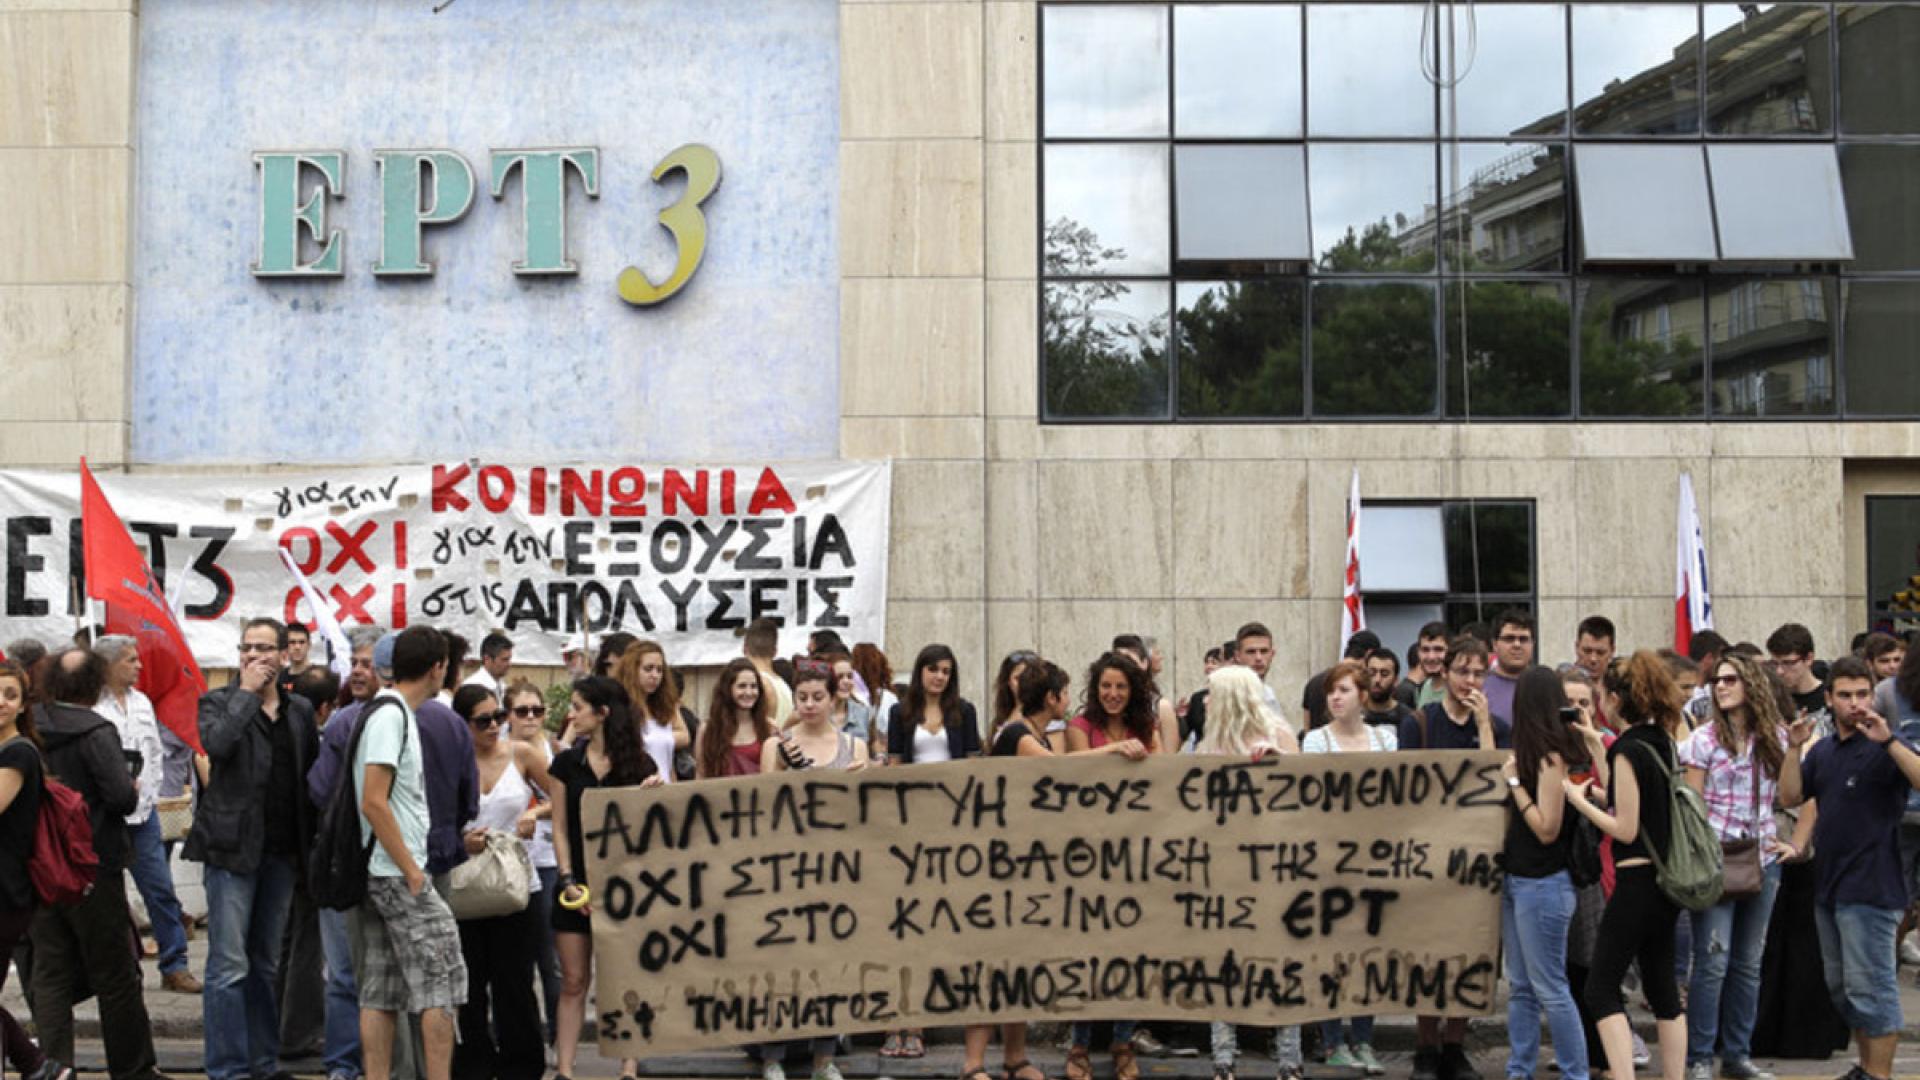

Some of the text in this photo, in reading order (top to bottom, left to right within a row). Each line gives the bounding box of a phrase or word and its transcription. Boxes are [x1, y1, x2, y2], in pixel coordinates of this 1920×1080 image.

[252, 143, 723, 308] ΕΡΤ 3
[273, 463, 797, 518] για την ΚΟΙΝΩΝΙΑ
[278, 513, 856, 576] ΟΧΙ για την ΕΞΟΥΣΙΑ
[422, 582, 506, 618] στις
[504, 576, 854, 633] ΑΠΟΛΥΣΕΙΣ
[586, 775, 1006, 858] ΑΛΛΗΛΕΓΓΥΗ
[1031, 777, 1151, 813] ΣΤΟΥΣ
[603, 861, 708, 921] ΟΧΙ
[724, 850, 862, 898] ΣΤΗΝ
[890, 836, 1211, 887] ΥΠΟΒΑΘΜΙΣΗ
[1239, 840, 1319, 883] ΤΗΣ
[1337, 838, 1434, 880] ΖΩΗΣ
[639, 888, 1400, 972] ΟΧΙ ΣΤΟ ΚΛΕΙΣΙΜΟ ΤΗΣ ΕΡΤ
[687, 990, 898, 1034] ΤΜΗΜΑΤΟΣ
[923, 949, 1306, 1014] ΔΗΜΟΣΙΟΓΡΑΦΙΑΣ
[1361, 957, 1493, 1011] ΜΜΕ
